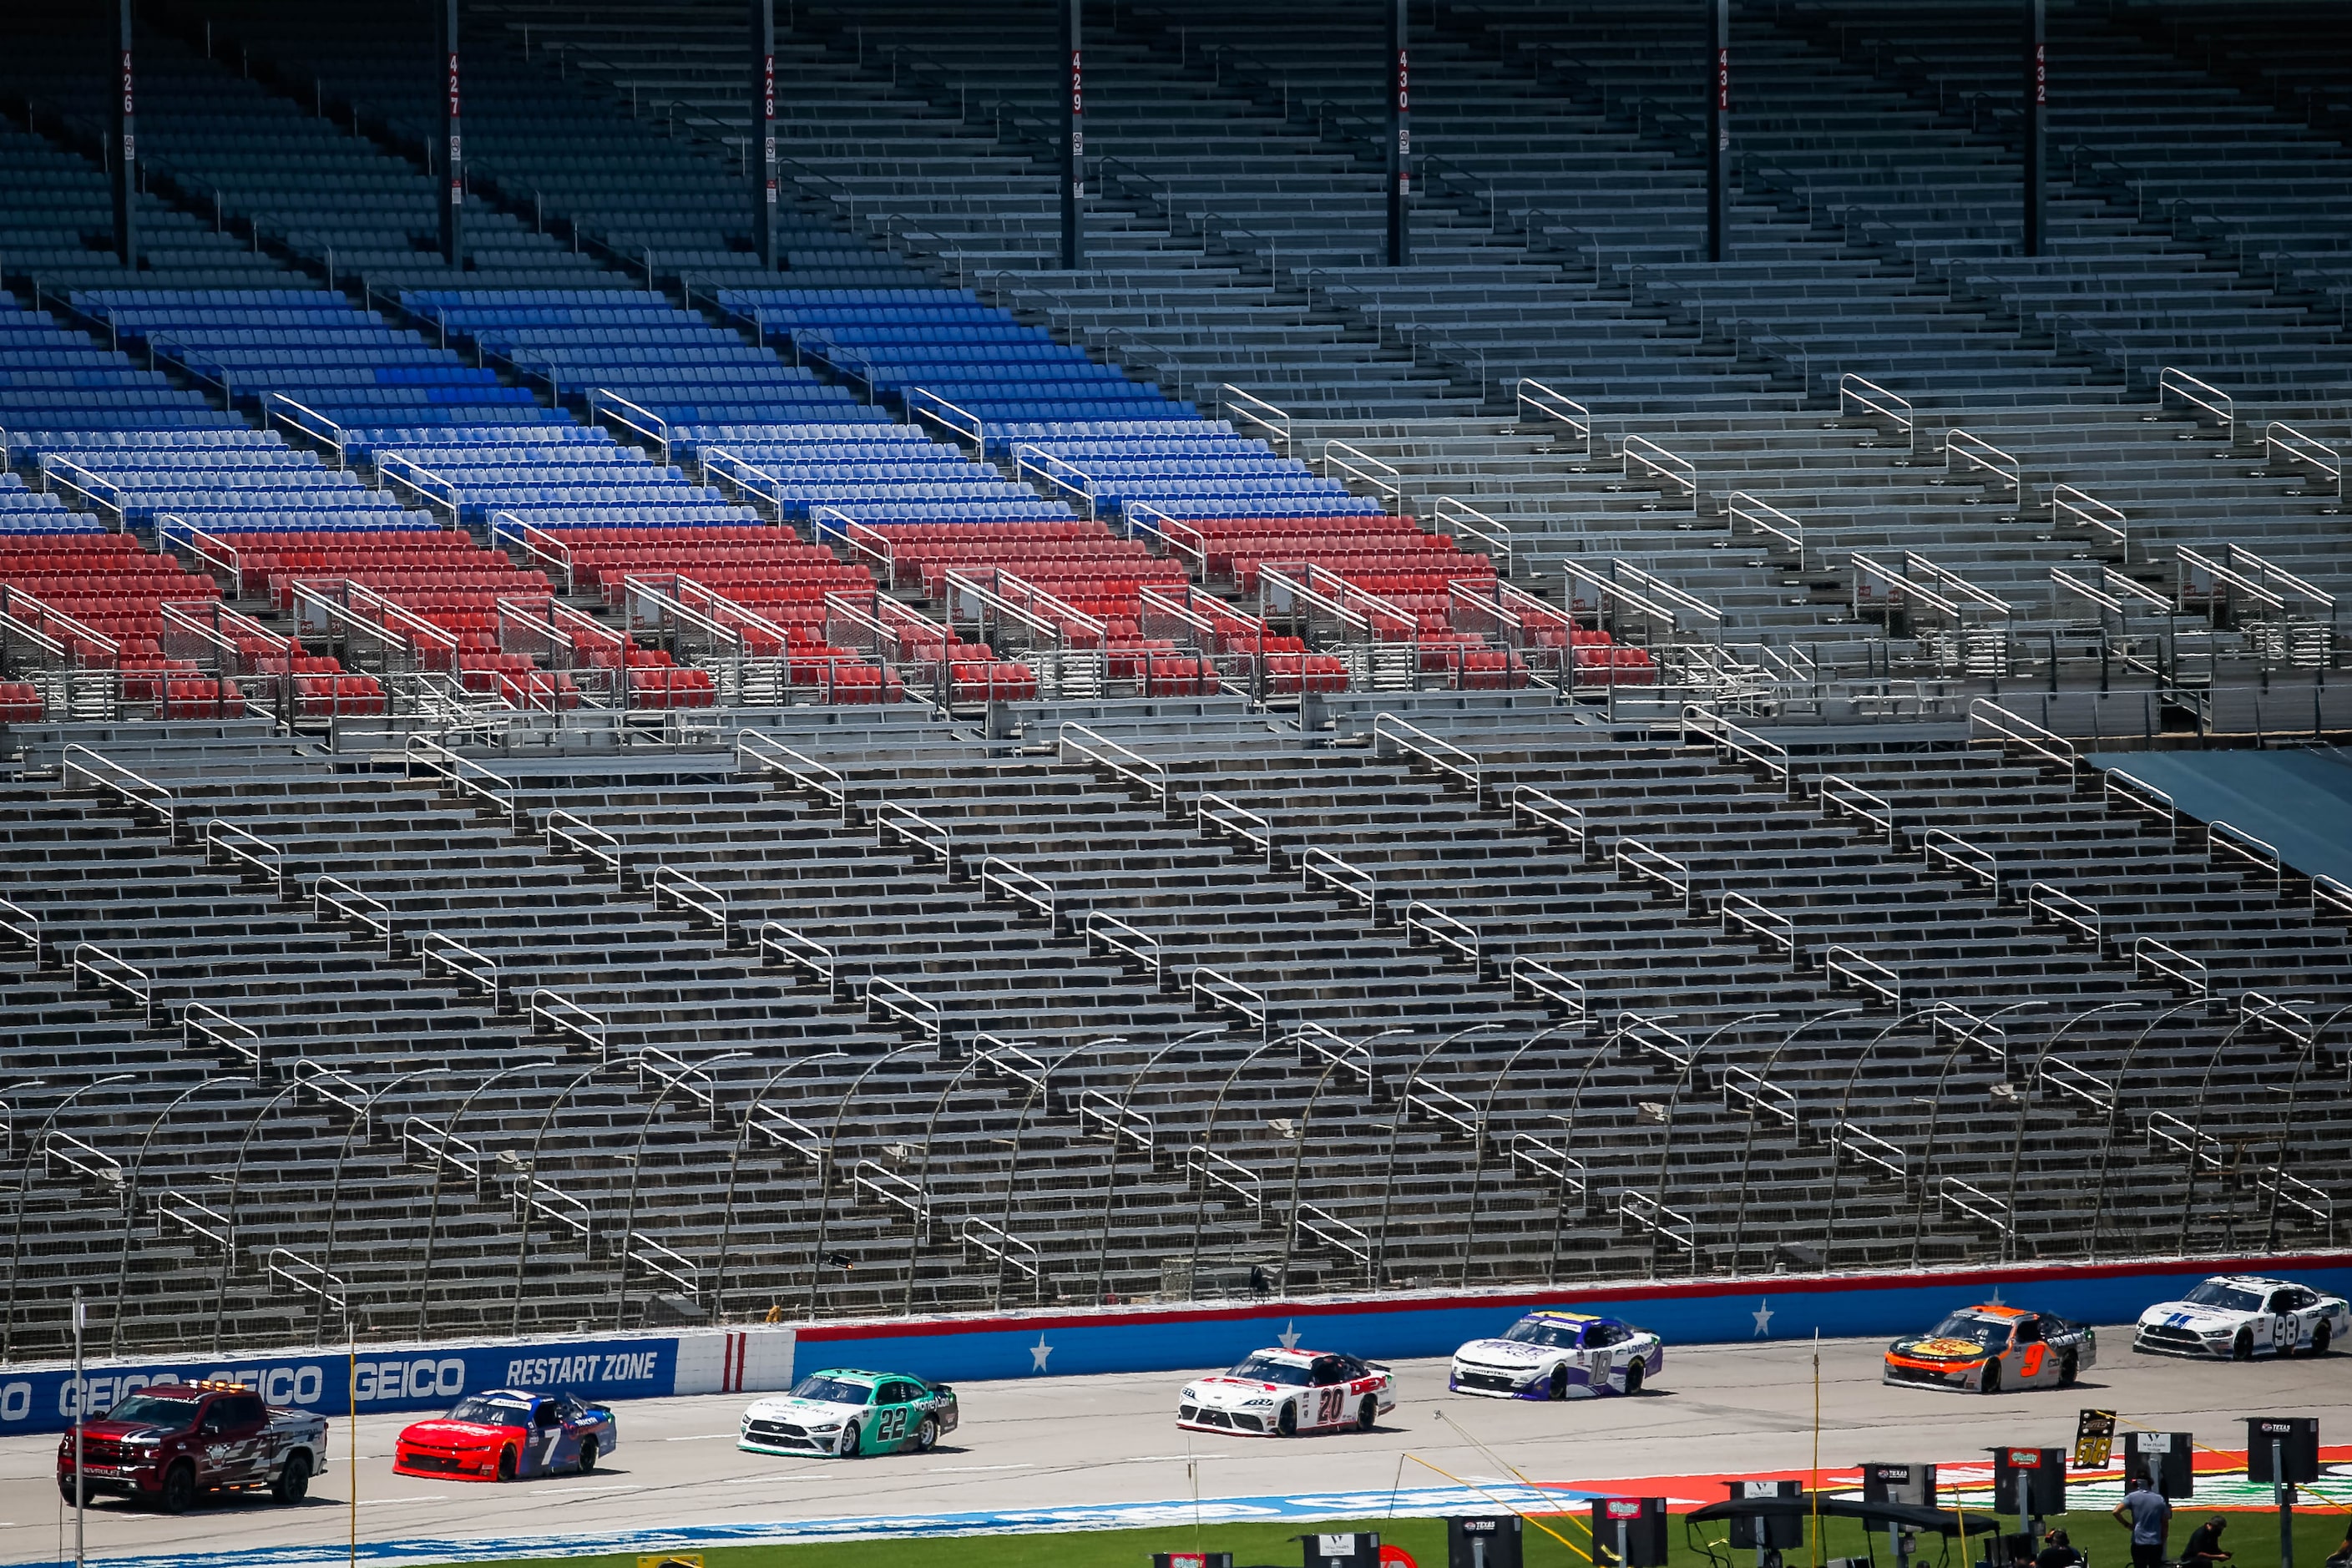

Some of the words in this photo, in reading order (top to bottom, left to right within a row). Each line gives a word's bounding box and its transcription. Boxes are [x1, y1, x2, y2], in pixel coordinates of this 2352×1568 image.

[123, 53, 133, 113] 426
[450, 55, 459, 114] 427
[766, 58, 774, 115] 428
[1073, 52, 1081, 110] 429
[1399, 51, 1408, 108] 430
[1720, 50, 1728, 106] 431
[2036, 46, 2046, 101] 432
[2274, 1314, 2299, 1347] 98
[352, 1358, 465, 1401] GEICO
[506, 1355, 601, 1387] RESTART
[601, 1352, 658, 1381] ZONE
[2020, 1343, 2046, 1378] 9
[877, 1407, 908, 1443] 22
[1317, 1386, 1344, 1425] 20
[541, 1428, 561, 1465] 7
[2075, 1437, 2112, 1465] 68
[1476, 1521, 1495, 1530] TEXAS
